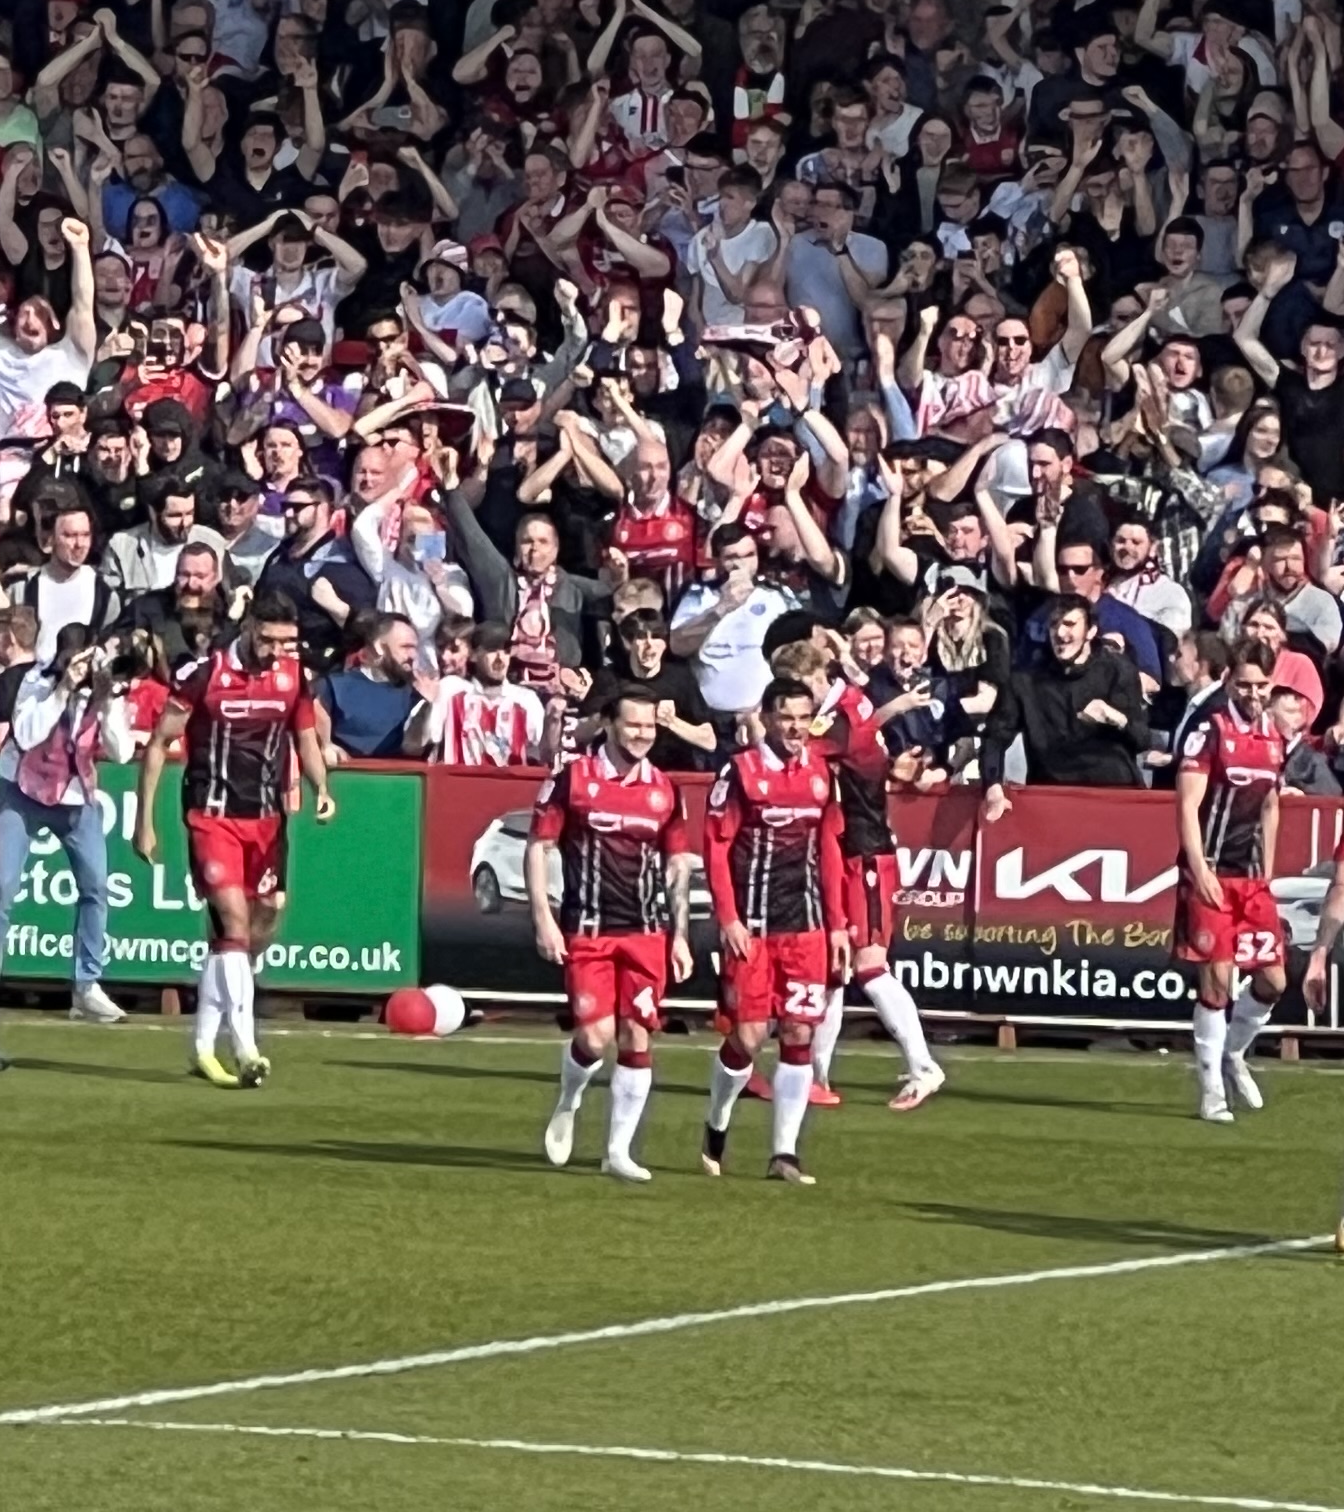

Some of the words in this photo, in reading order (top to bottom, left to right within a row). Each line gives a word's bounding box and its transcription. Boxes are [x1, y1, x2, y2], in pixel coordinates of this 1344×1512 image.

[152, 864, 208, 912] Lt
[1064, 920, 1114, 948] The
[1123, 923, 1171, 950] Bor
[784, 982, 828, 1016] 23
